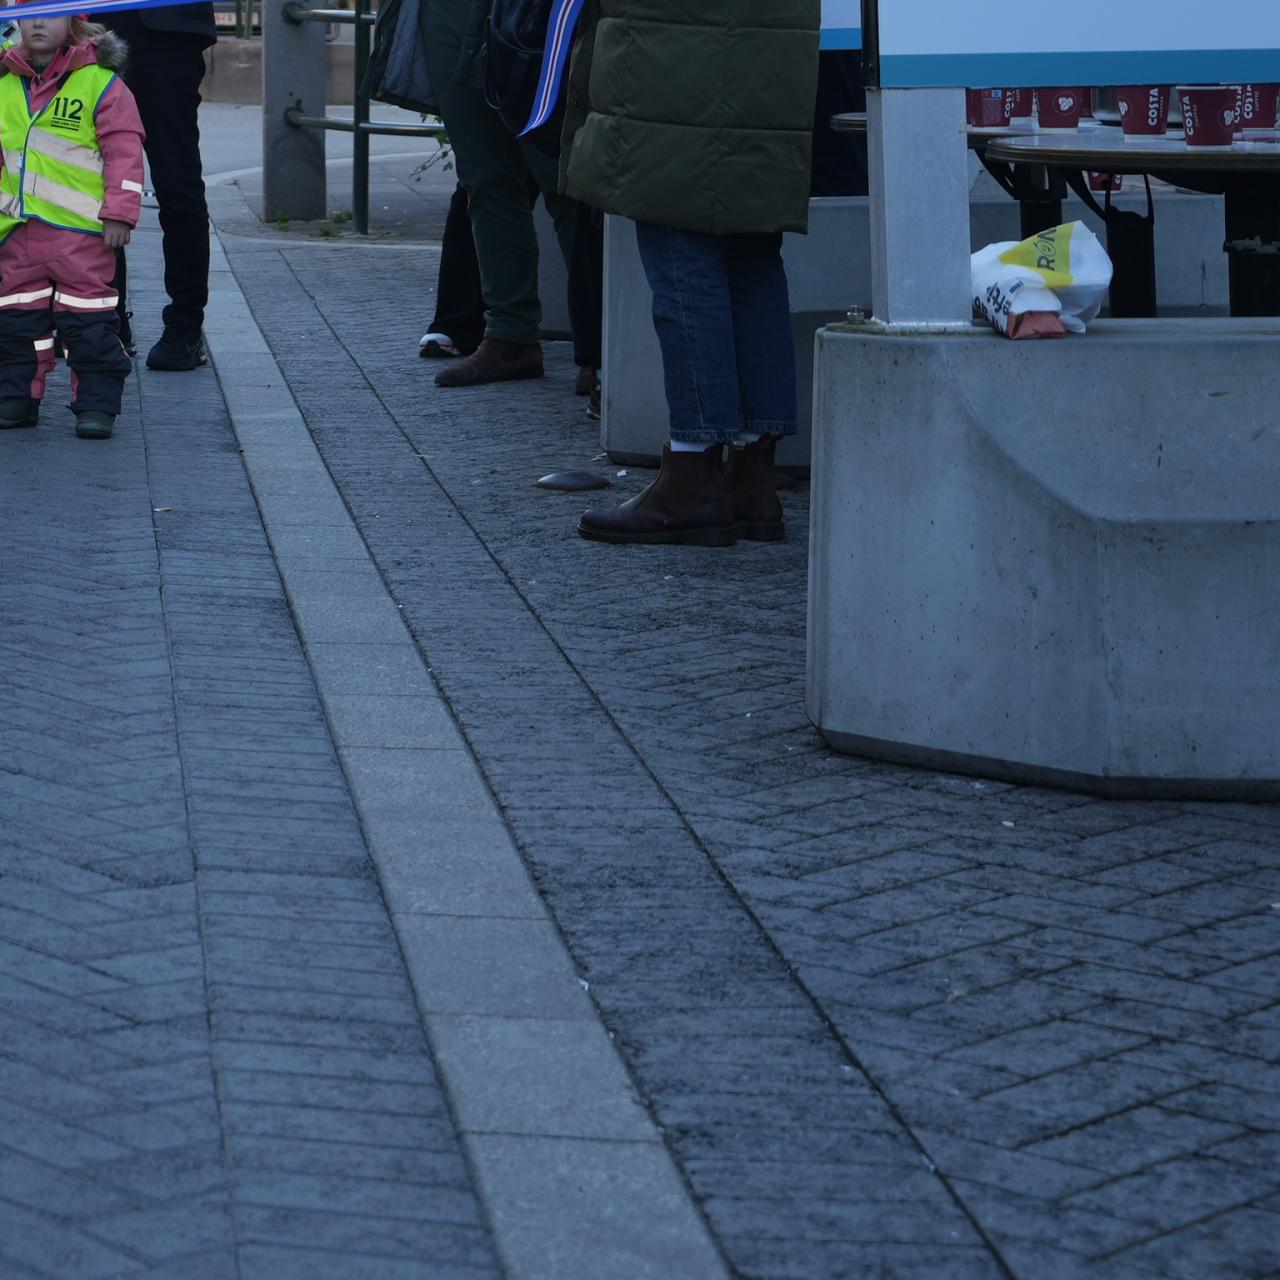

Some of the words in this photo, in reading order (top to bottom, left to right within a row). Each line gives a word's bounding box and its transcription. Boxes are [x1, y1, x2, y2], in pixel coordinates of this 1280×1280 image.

[54, 96, 84, 121] 112
[1004, 90, 1013, 118] COST
[1147, 87, 1159, 126] COSTA
[1182, 95, 1194, 136] COSTA
